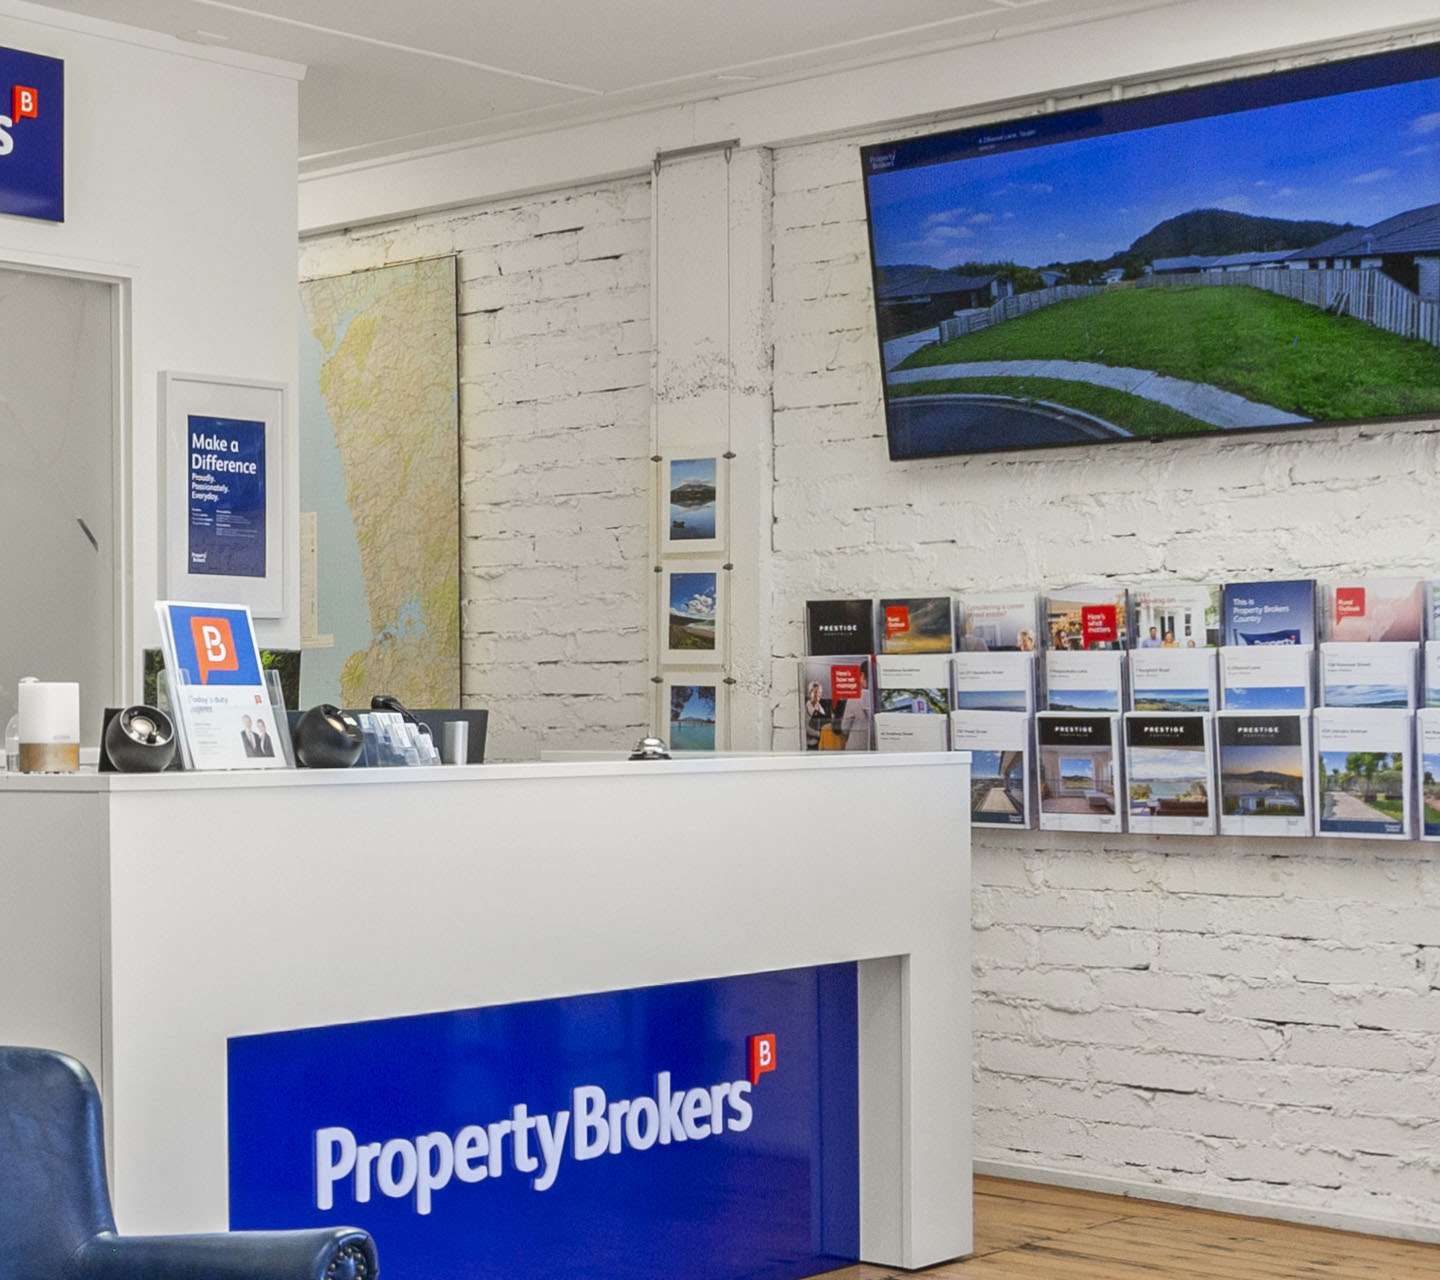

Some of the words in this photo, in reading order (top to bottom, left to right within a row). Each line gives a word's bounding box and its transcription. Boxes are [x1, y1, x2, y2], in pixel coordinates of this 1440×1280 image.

[192, 433, 228, 451] Make
[230, 440, 239, 452] a
[191, 453, 257, 475] Difference
[1233, 607, 1263, 616] Property
[1263, 605, 1290, 613] Brokers
[819, 624, 858, 632] PRESTIGE
[202, 625, 227, 663] B
[758, 1041, 771, 1067] B
